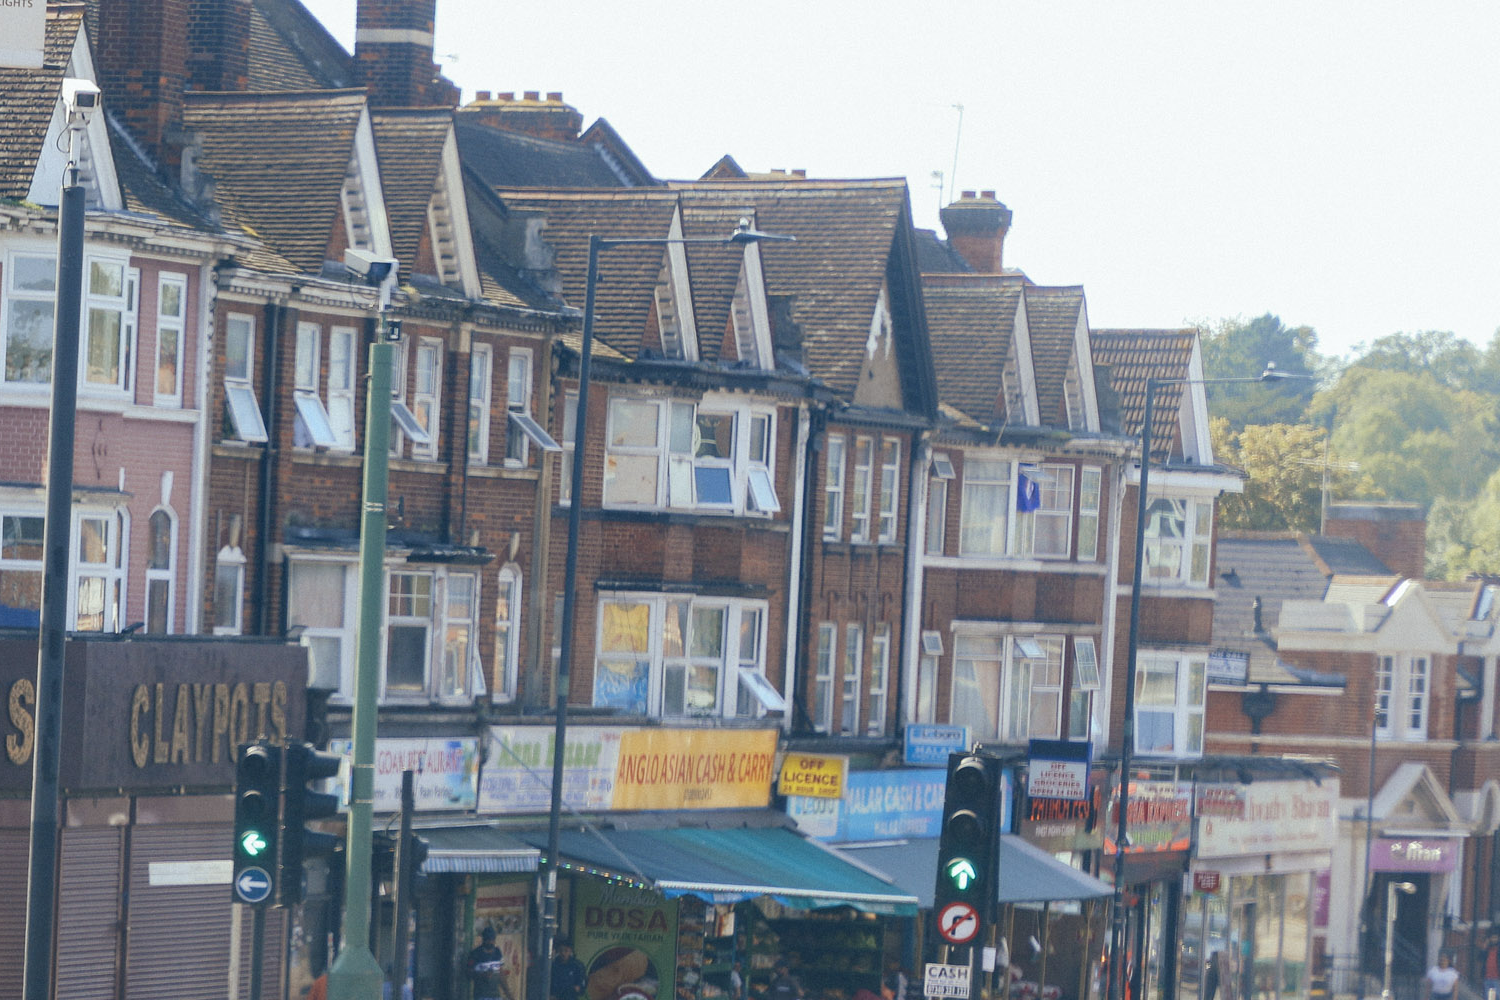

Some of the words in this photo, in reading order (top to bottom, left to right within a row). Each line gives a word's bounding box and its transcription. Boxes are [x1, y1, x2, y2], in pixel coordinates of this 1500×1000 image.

[130, 680, 288, 769] CLAYPOTS
[618, 754, 659, 785] ANGLO
[661, 754, 693, 784] ASIAN
[695, 752, 725, 783] CASH
[727, 753, 735, 783] &
[738, 752, 774, 783] CARRY
[784, 771, 838, 786] LICENCE
[585, 906, 668, 932] DOSA
[928, 966, 968, 979] CASH
